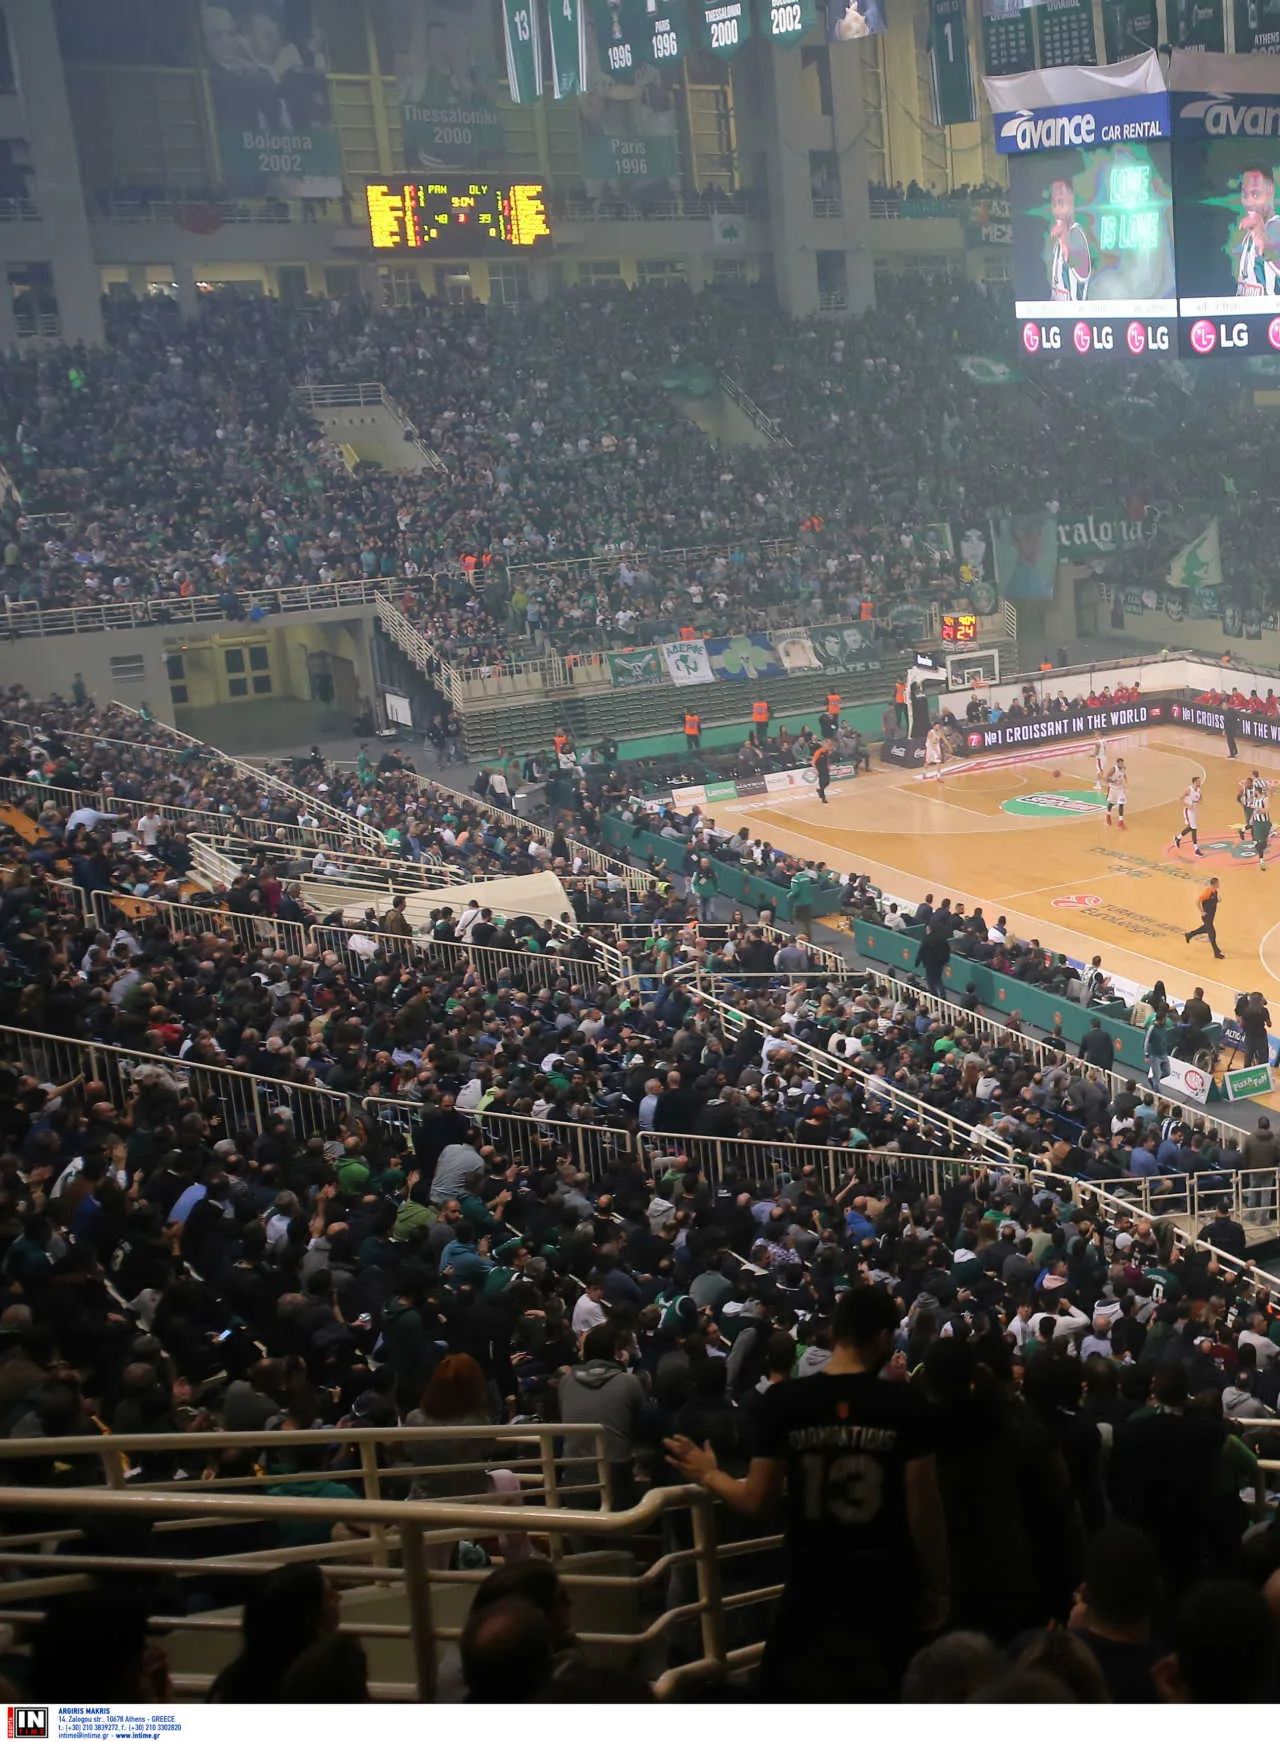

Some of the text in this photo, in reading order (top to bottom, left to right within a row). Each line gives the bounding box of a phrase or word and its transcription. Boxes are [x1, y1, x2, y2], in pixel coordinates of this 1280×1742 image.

[514, 10, 530, 41] 13
[655, 19, 671, 32] PARIS
[771, 5, 802, 34] 2002
[652, 32, 678, 58] 1996
[711, 20, 738, 48] 2000
[608, 44, 632, 69] 1996
[242, 131, 313, 154] Bologna
[433, 127, 472, 145] 2000
[1016, 112, 1162, 150] avance CAR RENTAL
[611, 138, 646, 154] Paris
[258, 154, 303, 173] 2002
[615, 159, 648, 175] 1996
[428, 185, 489, 195] PAN OLY
[1100, 212, 1117, 249] IS
[1041, 325, 1169, 350] LG LG LG
[1220, 322, 1249, 348] LG
[957, 625, 974, 639] 24
[1006, 721, 1069, 743] CROISSANT
[1072, 718, 1084, 733] IN
[1087, 714, 1107, 731] THE
[1110, 707, 1148, 727] WORLD
[1242, 719, 1251, 735] IN
[1253, 721, 1269, 739] THE
[800, 1452, 885, 1525] 13
